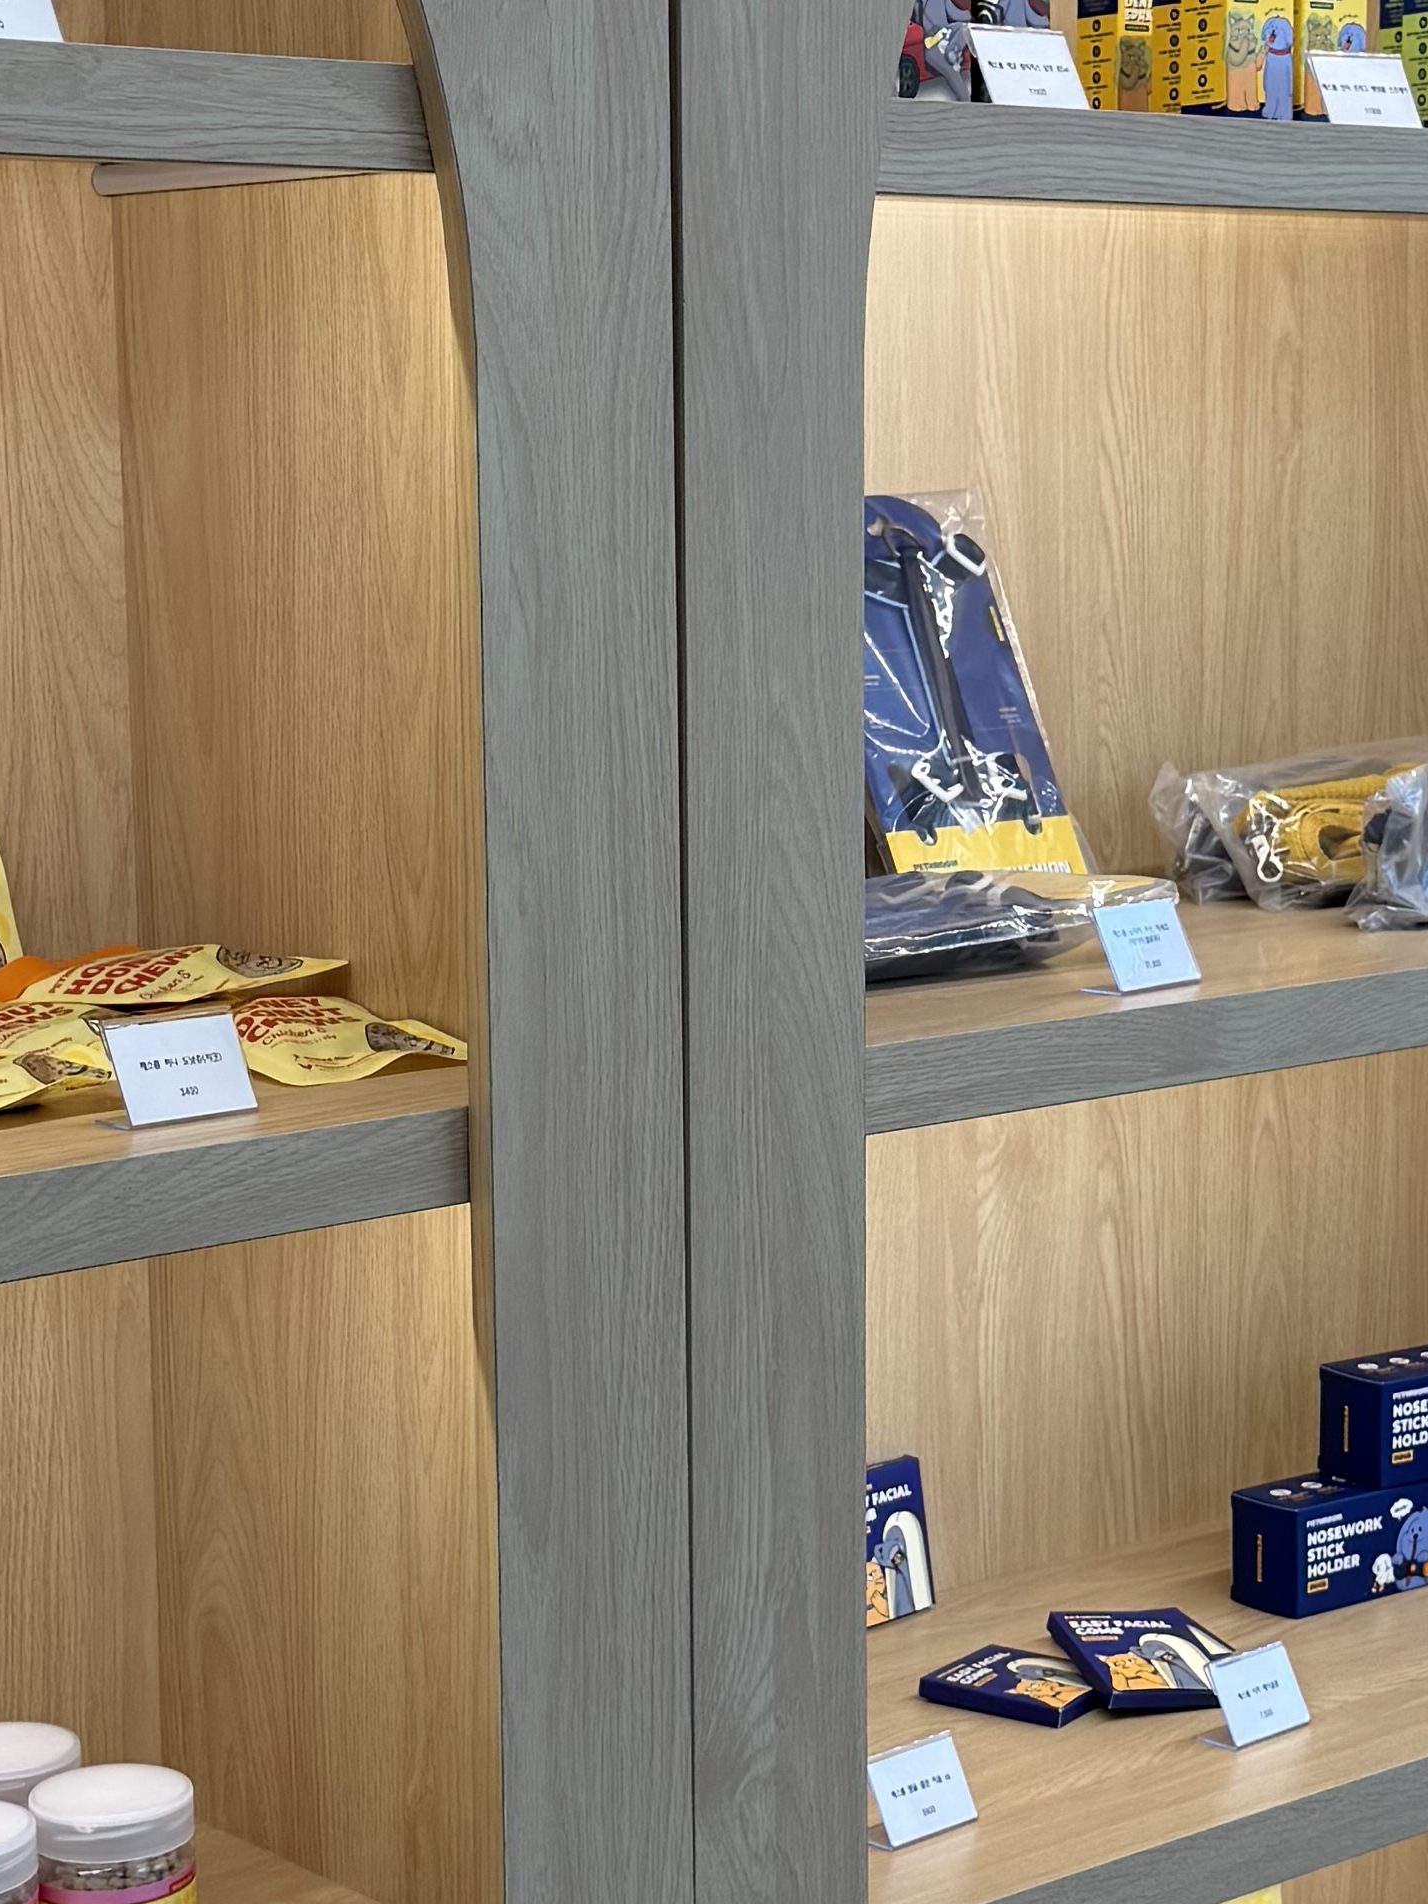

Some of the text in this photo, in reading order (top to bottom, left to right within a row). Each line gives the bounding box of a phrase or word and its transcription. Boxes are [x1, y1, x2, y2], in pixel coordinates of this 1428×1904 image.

[1307, 1516, 1383, 1547] NOSEWORK
[1307, 1542, 1346, 1562] STICK
[1307, 1553, 1361, 1579] HOLDER
